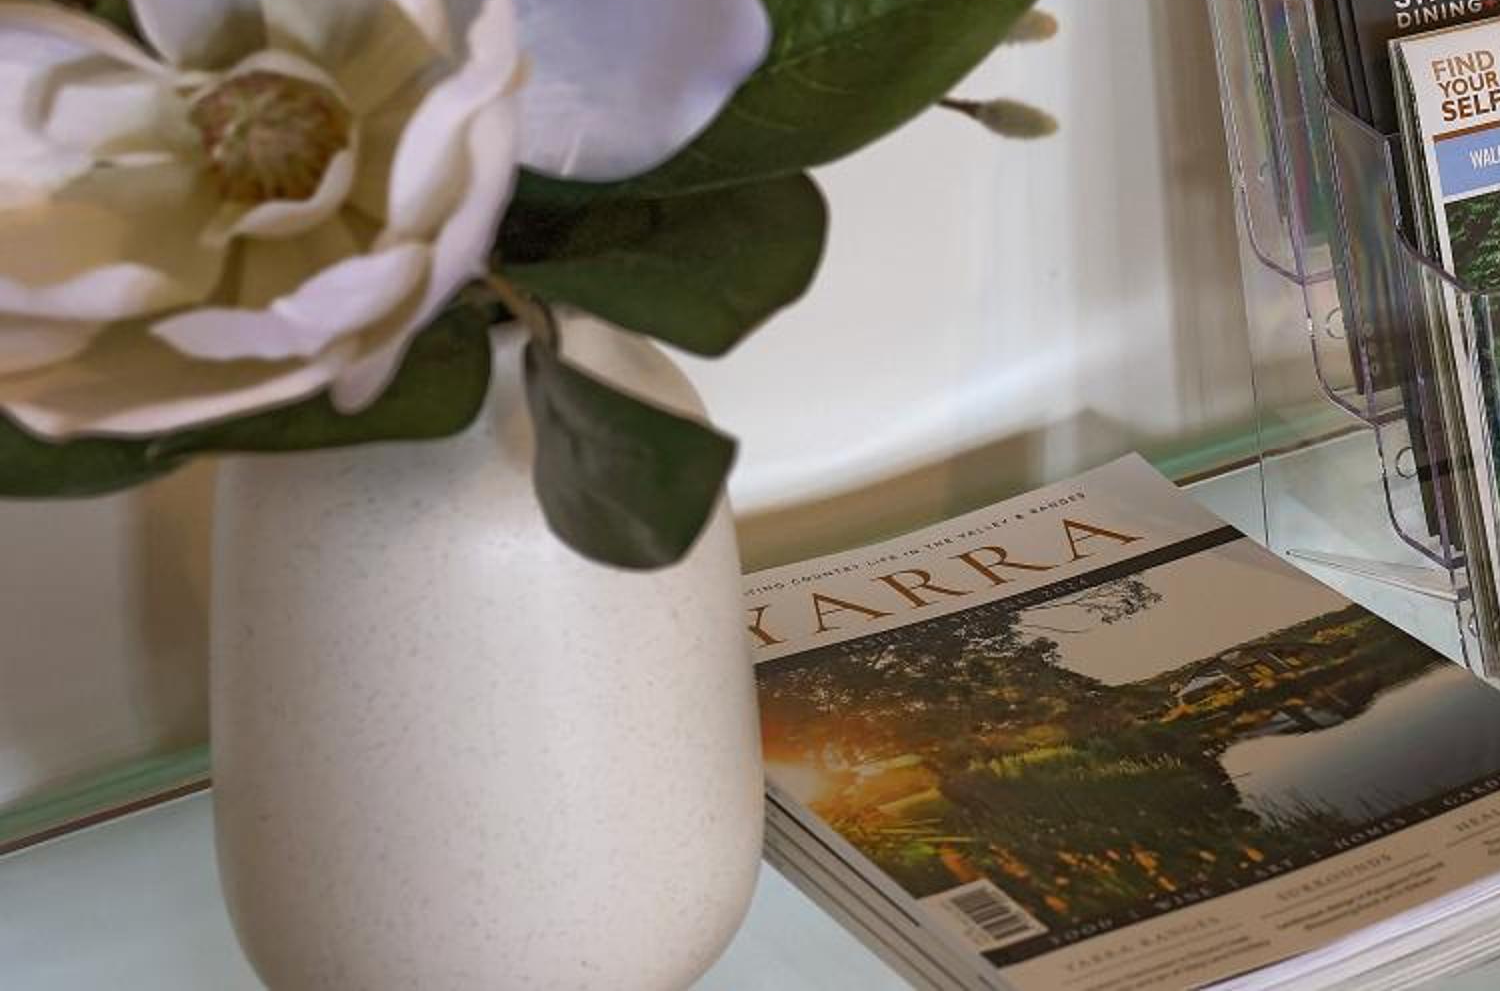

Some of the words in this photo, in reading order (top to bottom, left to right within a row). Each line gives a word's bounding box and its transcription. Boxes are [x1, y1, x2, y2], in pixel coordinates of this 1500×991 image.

[1431, 49, 1495, 80] FIND
[1437, 70, 1500, 98] YOUR
[1334, 816, 1406, 851] HOMES
